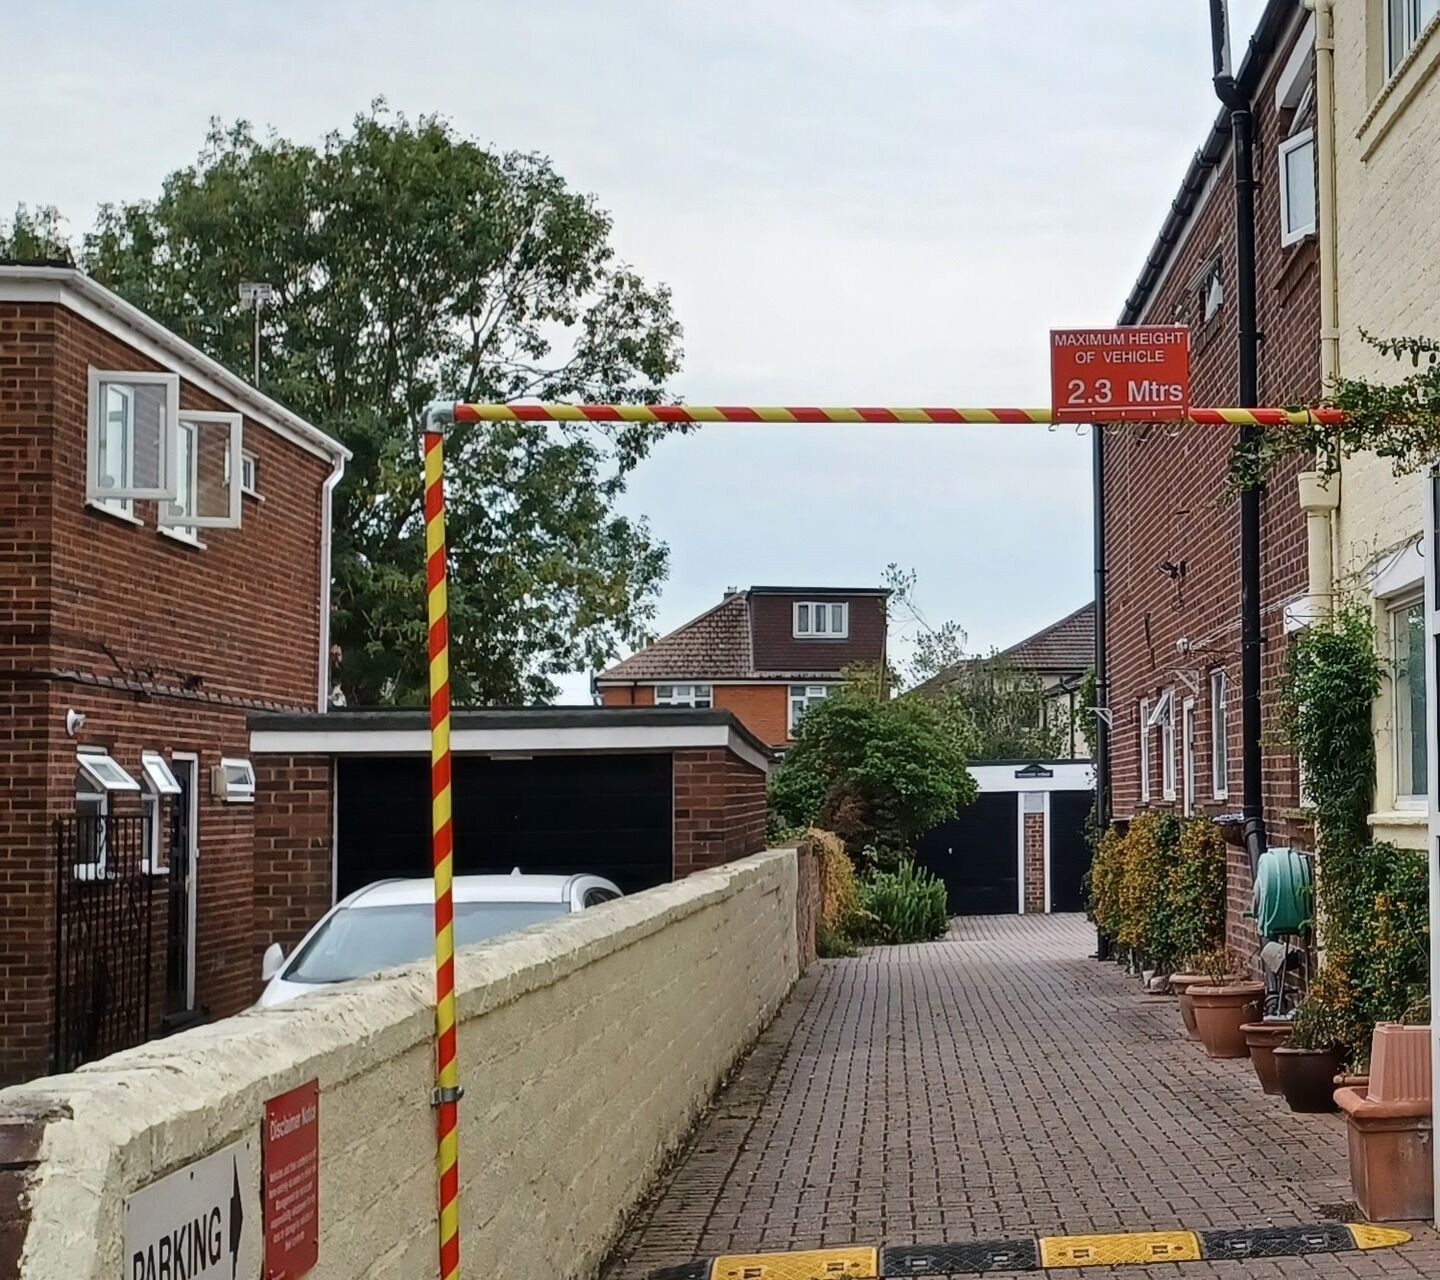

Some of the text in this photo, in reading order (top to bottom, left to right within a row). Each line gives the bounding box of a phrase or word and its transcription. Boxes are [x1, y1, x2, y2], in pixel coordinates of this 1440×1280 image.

[1055, 332, 1184, 346] MAXIMUM HEIGHT
[1075, 350, 1165, 364] OF VEHICLE
[1067, 378, 1184, 404] 2.3 Mtrs
